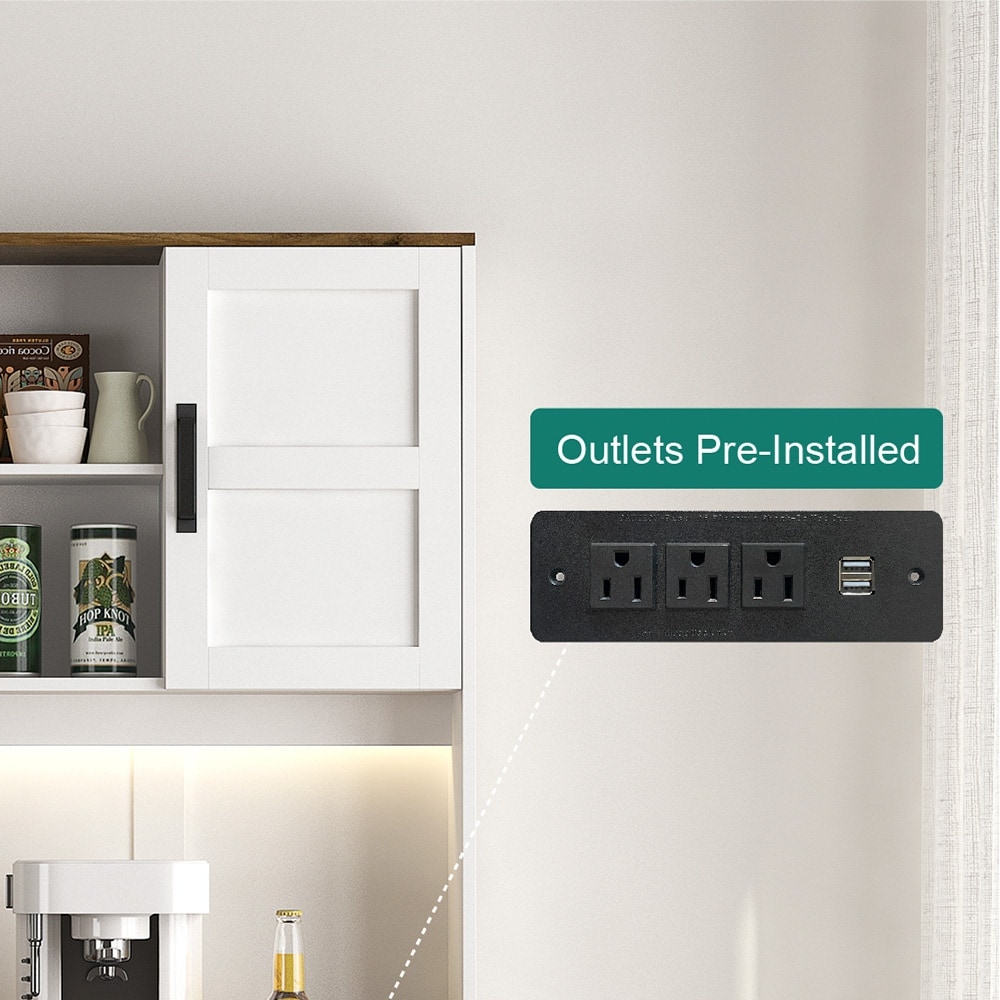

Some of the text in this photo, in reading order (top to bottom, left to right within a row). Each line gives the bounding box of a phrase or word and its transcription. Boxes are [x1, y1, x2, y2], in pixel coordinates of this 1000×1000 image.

[80, 608, 130, 626] HOP KNOT
[96, 624, 115, 636] IPA
